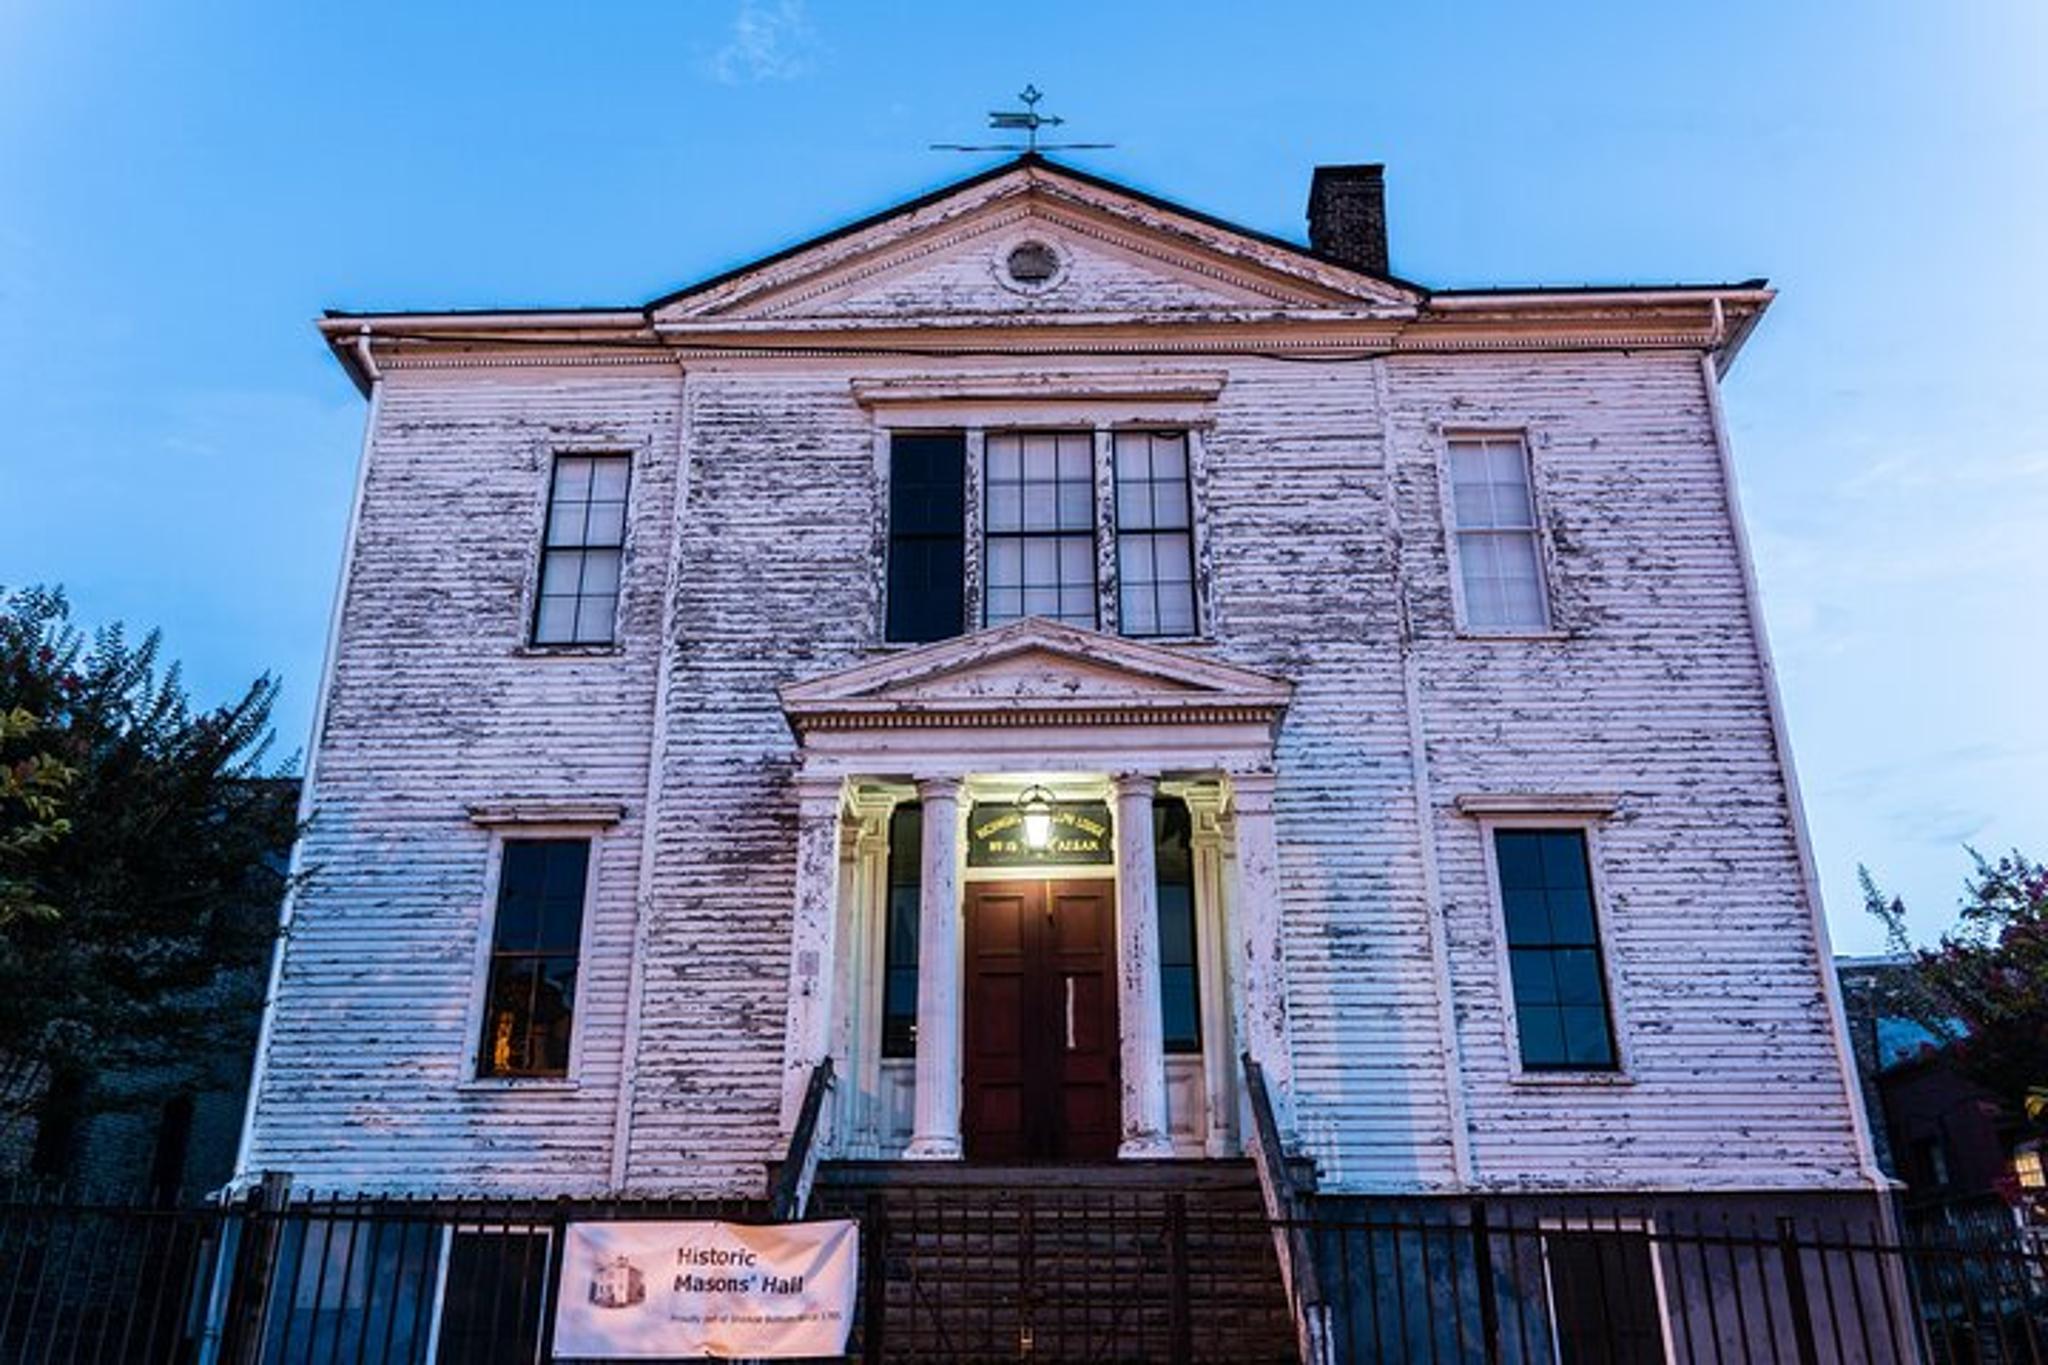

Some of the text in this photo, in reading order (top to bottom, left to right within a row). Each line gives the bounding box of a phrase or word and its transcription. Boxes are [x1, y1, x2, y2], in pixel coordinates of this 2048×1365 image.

[677, 1248, 757, 1267] Historic
[673, 1274, 804, 1295] Masons' Hall
